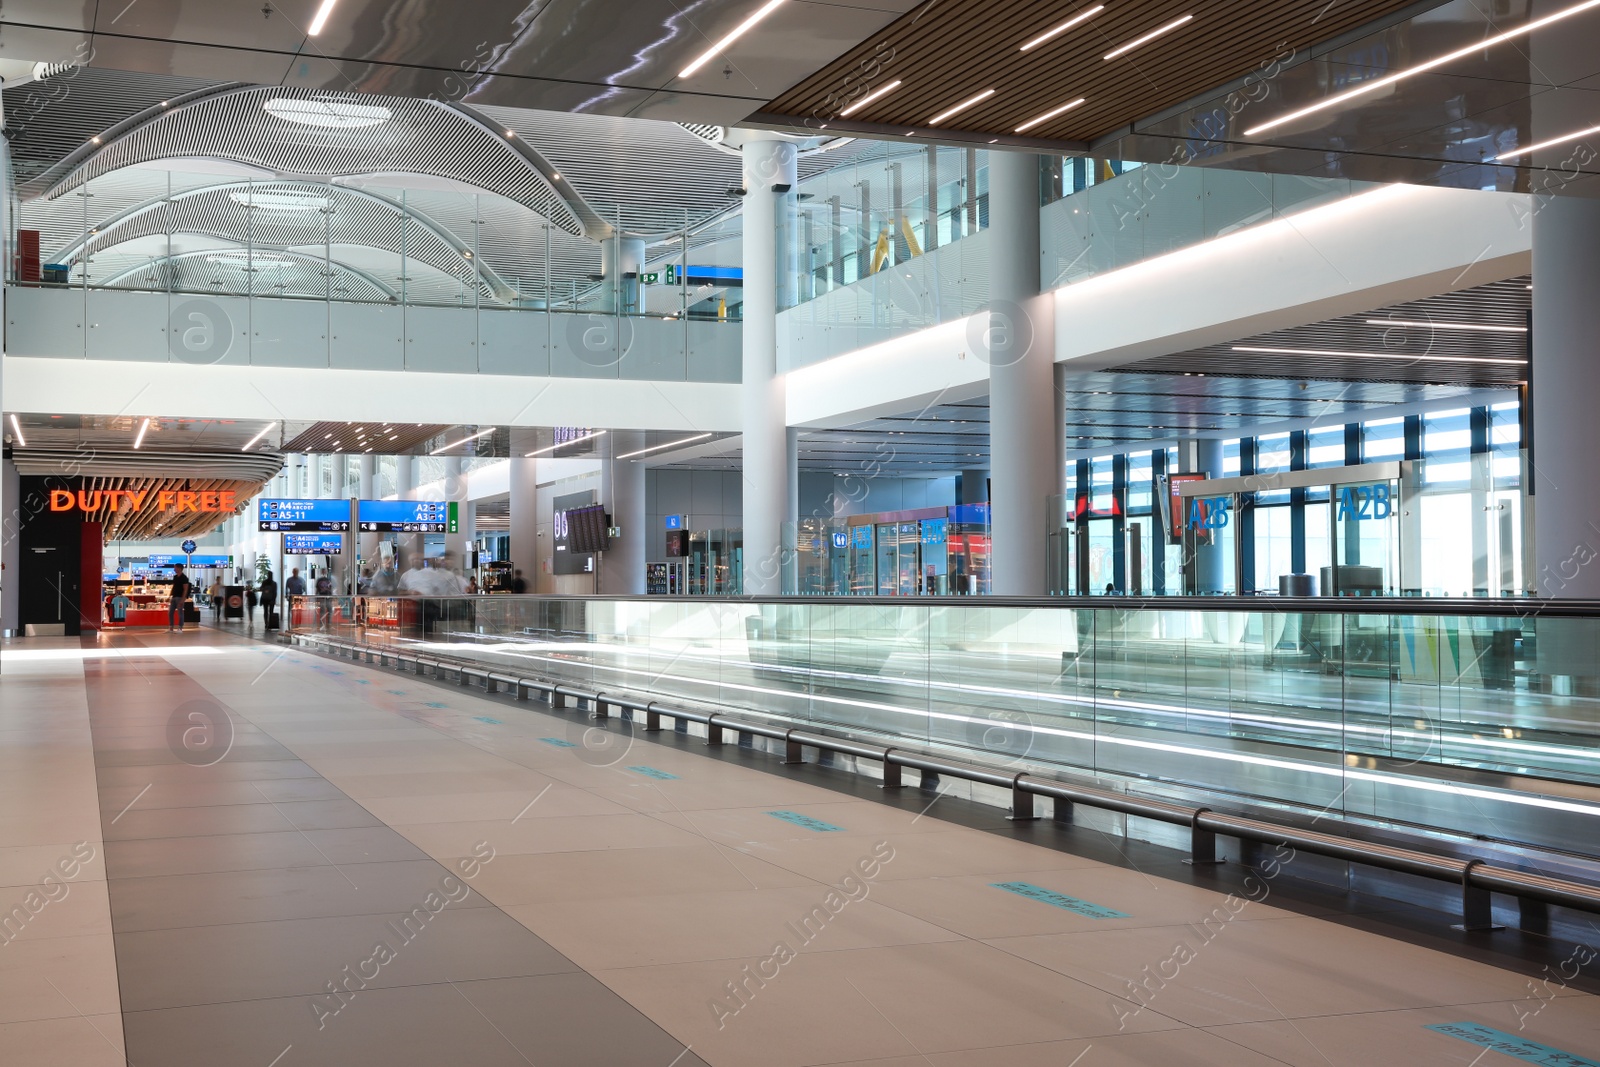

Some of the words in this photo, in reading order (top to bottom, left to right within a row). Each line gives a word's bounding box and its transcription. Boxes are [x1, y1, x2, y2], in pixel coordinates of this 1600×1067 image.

[50, 490, 148, 511] DUTY
[158, 490, 236, 512] FREE
[1188, 497, 1228, 530] A2B
[1338, 484, 1391, 521] A2B
[852, 526, 872, 549] A2B
